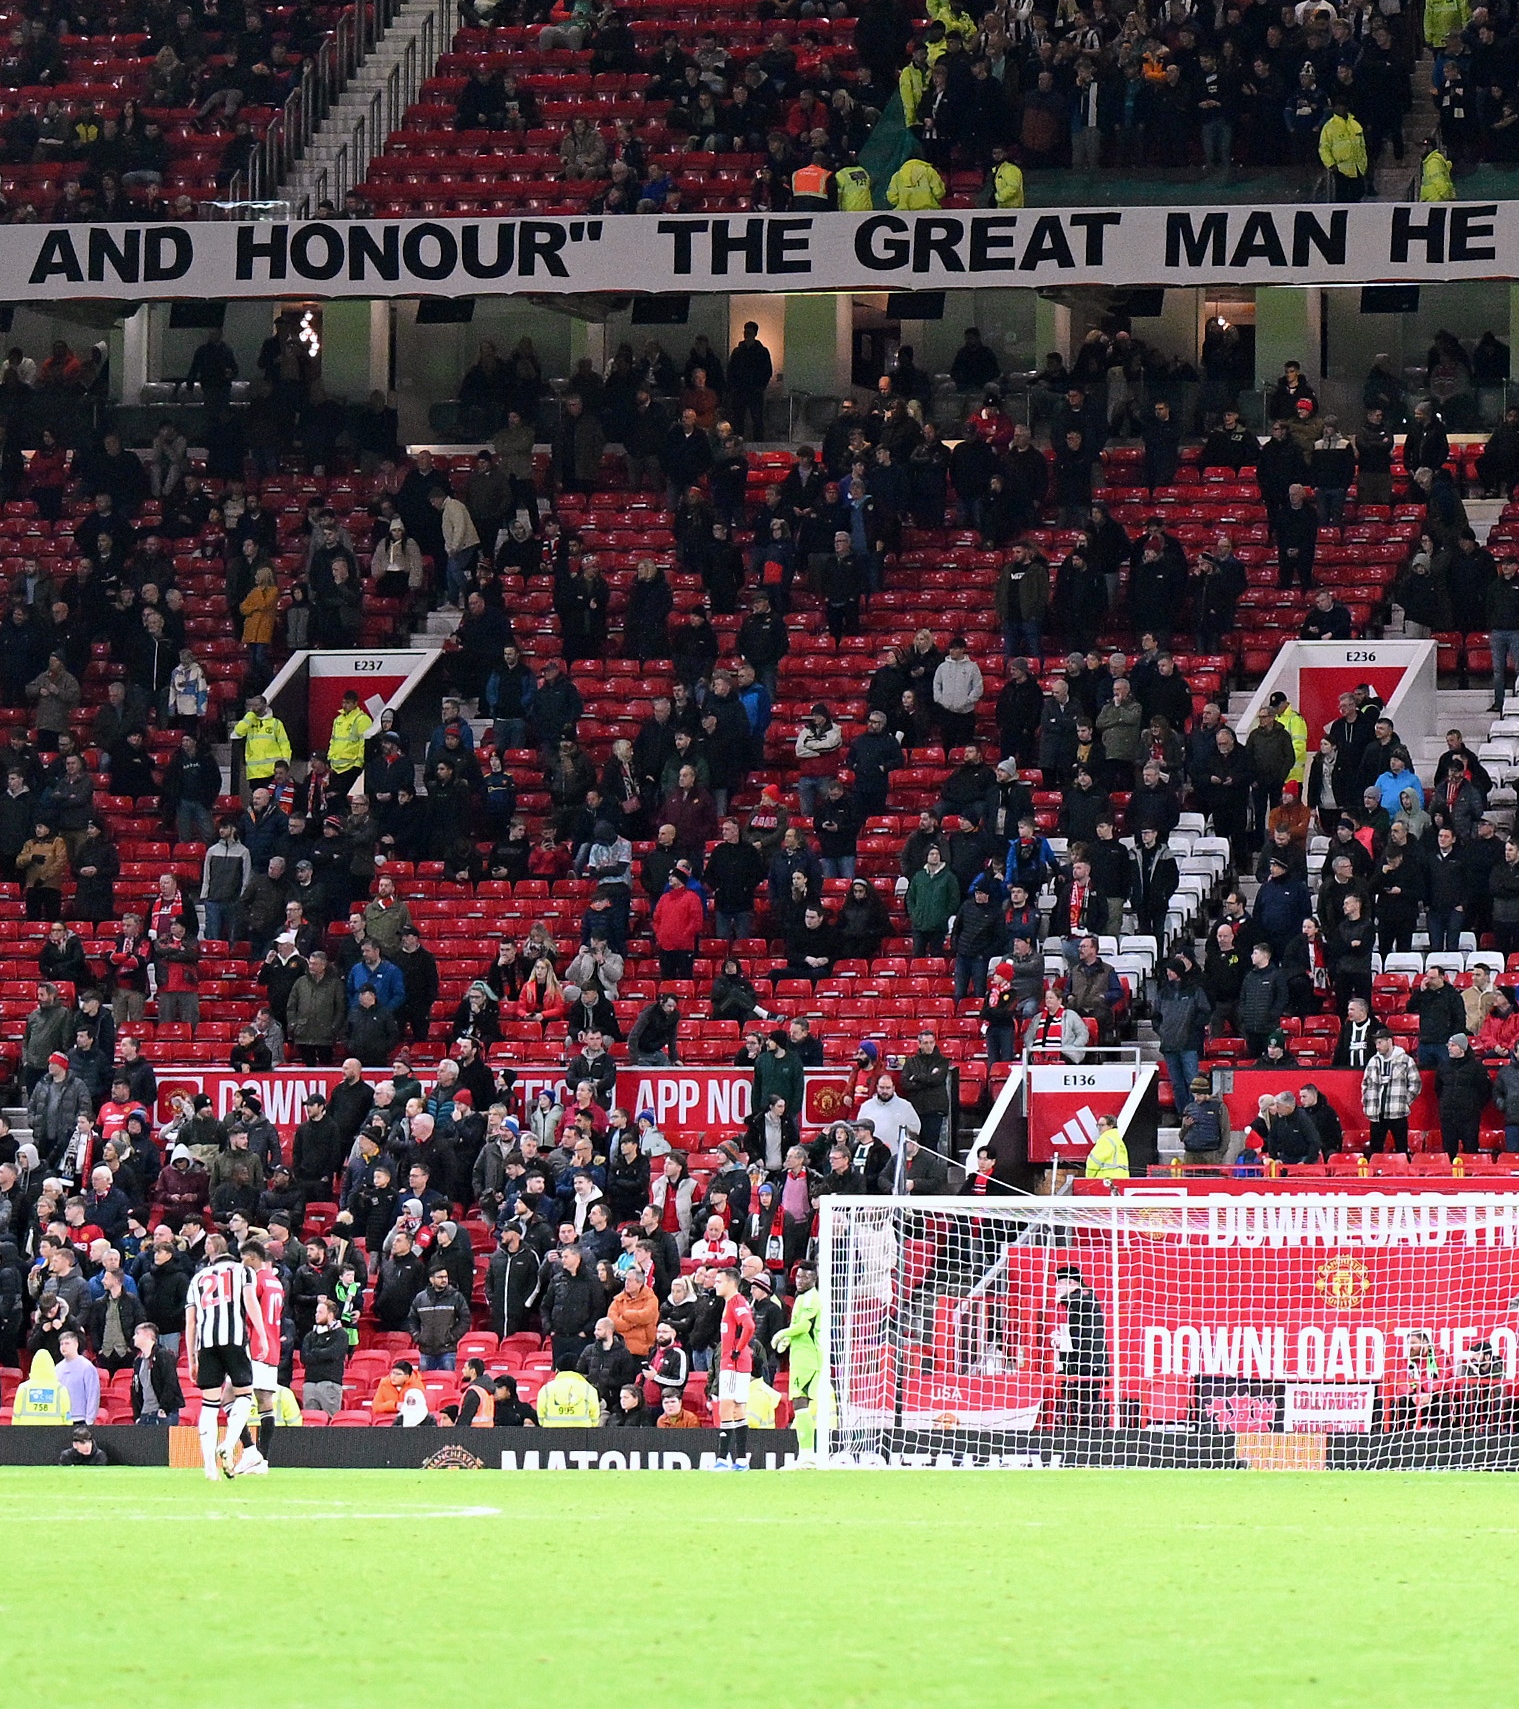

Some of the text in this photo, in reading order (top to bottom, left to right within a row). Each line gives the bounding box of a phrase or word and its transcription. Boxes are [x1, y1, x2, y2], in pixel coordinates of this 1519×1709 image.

[29, 224, 194, 284] AND
[236, 220, 603, 282] HONOUR"
[658, 218, 813, 276] THE
[854, 212, 1121, 273] GREAT
[1165, 208, 1348, 268] MAN
[1390, 204, 1498, 265] HE
[1346, 651, 1376, 662] E236
[354, 660, 383, 670] E237
[1063, 1075, 1096, 1085] E136
[634, 1079, 753, 1125] APP NO
[199, 1271, 233, 1309] 21
[1144, 1326, 1385, 1380] DOWNLOAD
[930, 1387, 963, 1401] USA
[33, 1403, 48, 1412] 758
